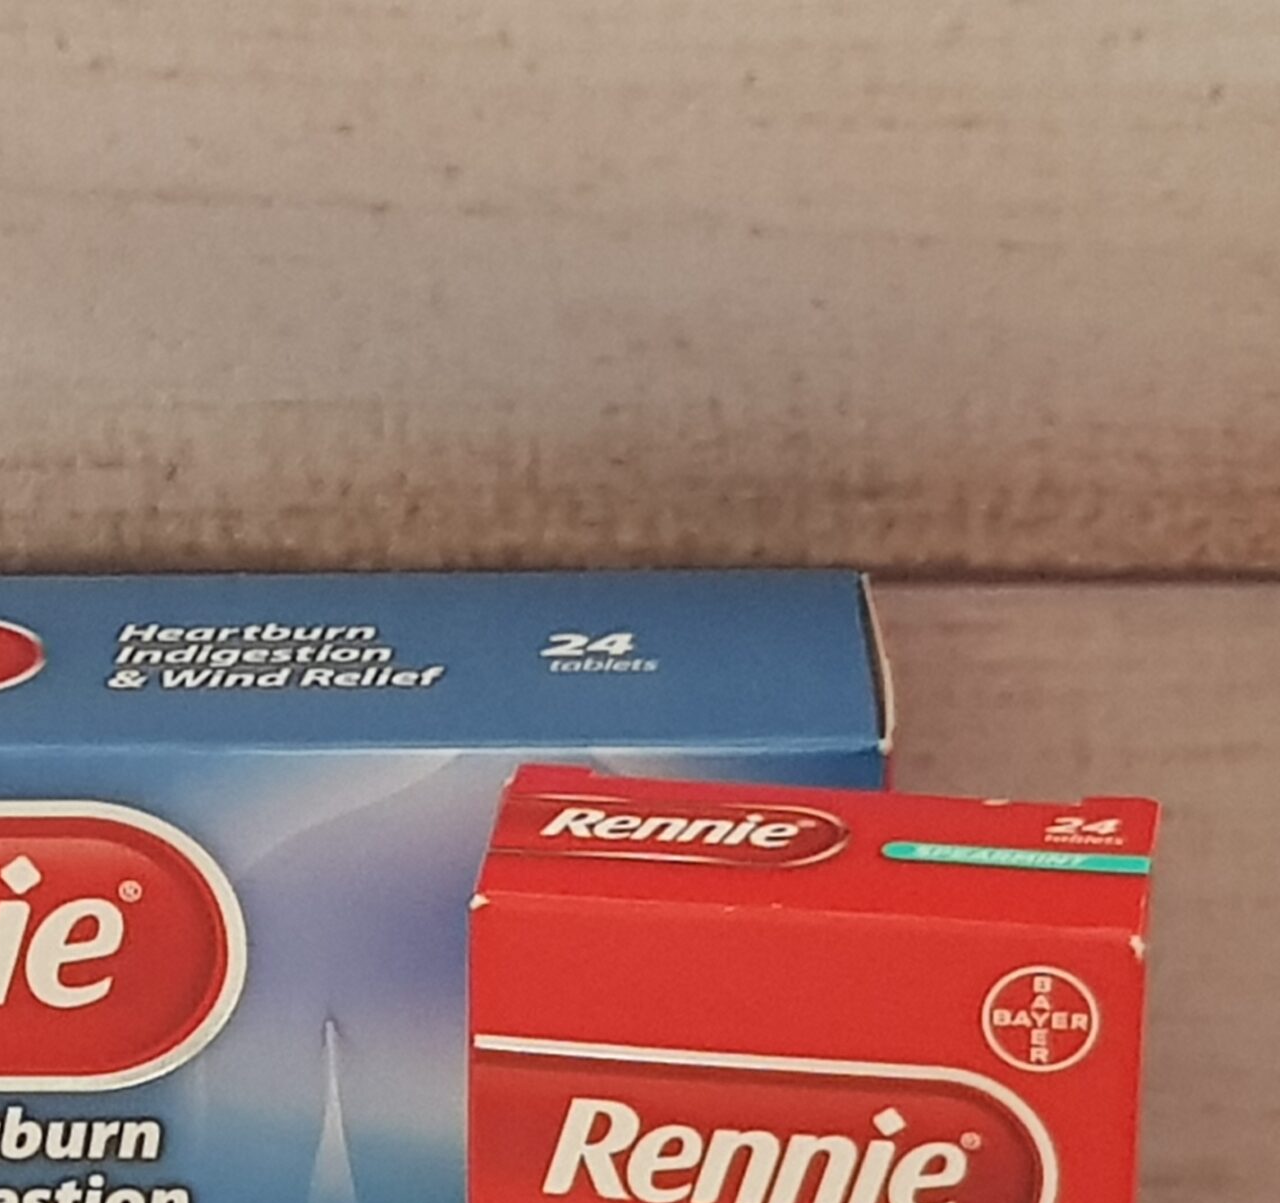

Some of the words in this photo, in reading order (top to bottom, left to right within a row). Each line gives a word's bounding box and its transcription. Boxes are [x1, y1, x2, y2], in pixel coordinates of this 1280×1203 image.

[118, 623, 376, 643] Heartburn
[116, 644, 391, 667] Indigestion
[540, 633, 634, 657] 24
[549, 656, 658, 673] tablets
[108, 667, 144, 689] &
[160, 667, 288, 688] Wind
[299, 667, 444, 689] Relief
[541, 807, 800, 849] Rennie
[1045, 817, 1122, 834] 24
[993, 1008, 1089, 1031] BAYER
